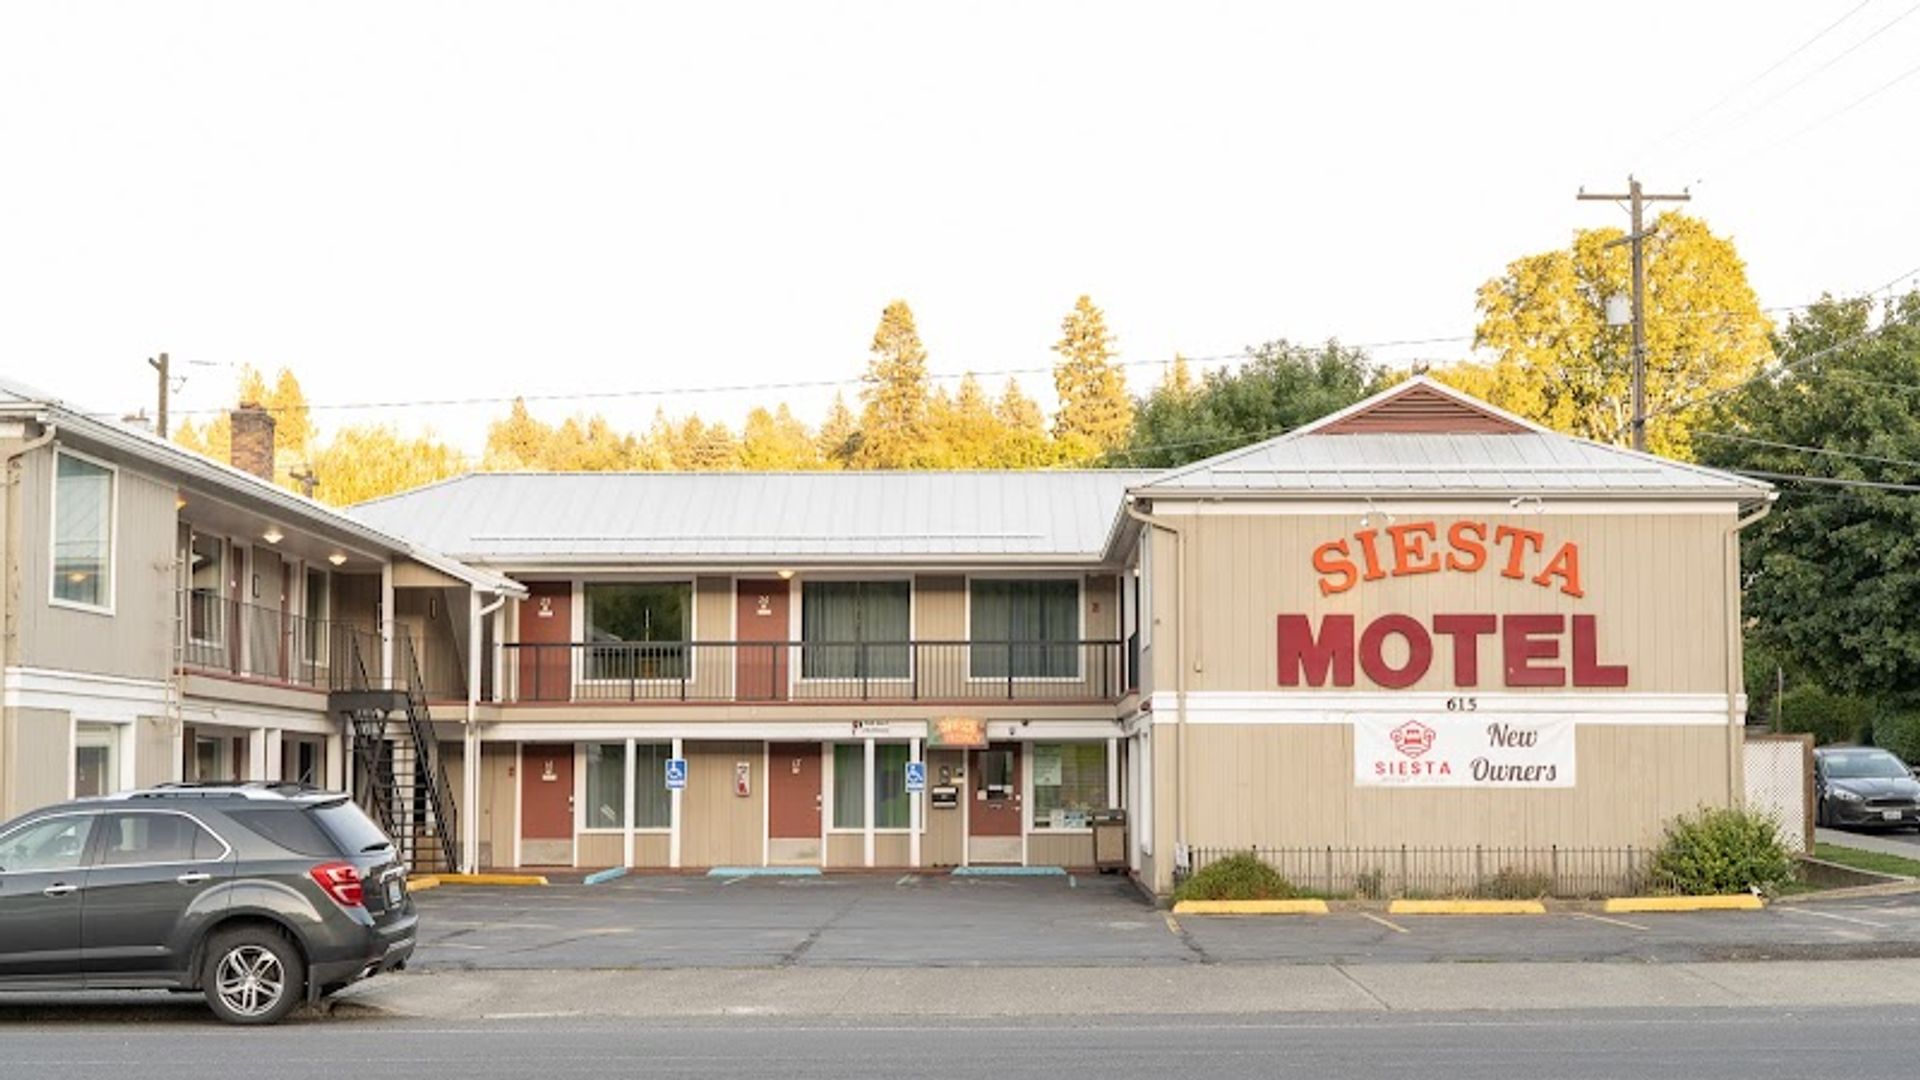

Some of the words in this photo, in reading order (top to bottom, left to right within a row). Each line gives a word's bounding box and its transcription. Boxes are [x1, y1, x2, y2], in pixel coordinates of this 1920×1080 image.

[1312, 520, 1584, 598] SIESTA
[1277, 614, 1628, 689] MOTEL
[1447, 697, 1477, 712] 615
[1486, 722, 1538, 748] New
[1375, 761, 1451, 775] SIESTA
[1469, 756, 1557, 781] Owners
